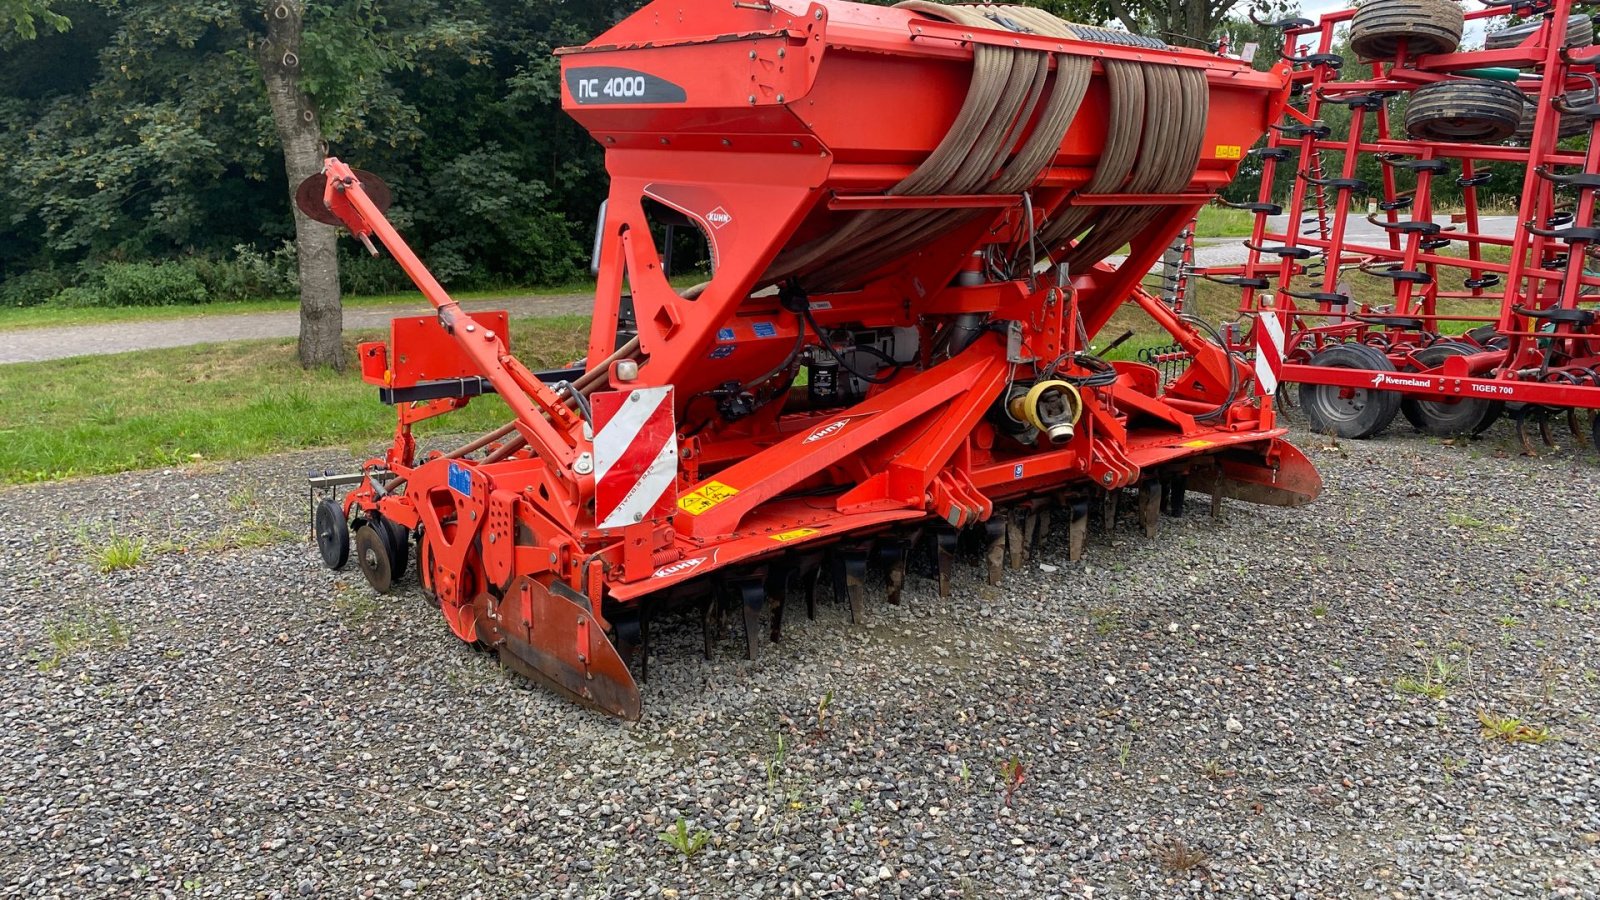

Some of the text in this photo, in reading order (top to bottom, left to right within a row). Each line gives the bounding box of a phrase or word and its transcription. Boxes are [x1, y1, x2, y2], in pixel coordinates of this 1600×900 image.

[603, 76, 645, 97] 4000
[708, 212, 729, 222] KUHN
[1385, 376, 1430, 387] Kverneland
[1472, 384, 1513, 394] TIGER 700
[808, 421, 845, 441] KUHN
[655, 559, 700, 577] KUHN
